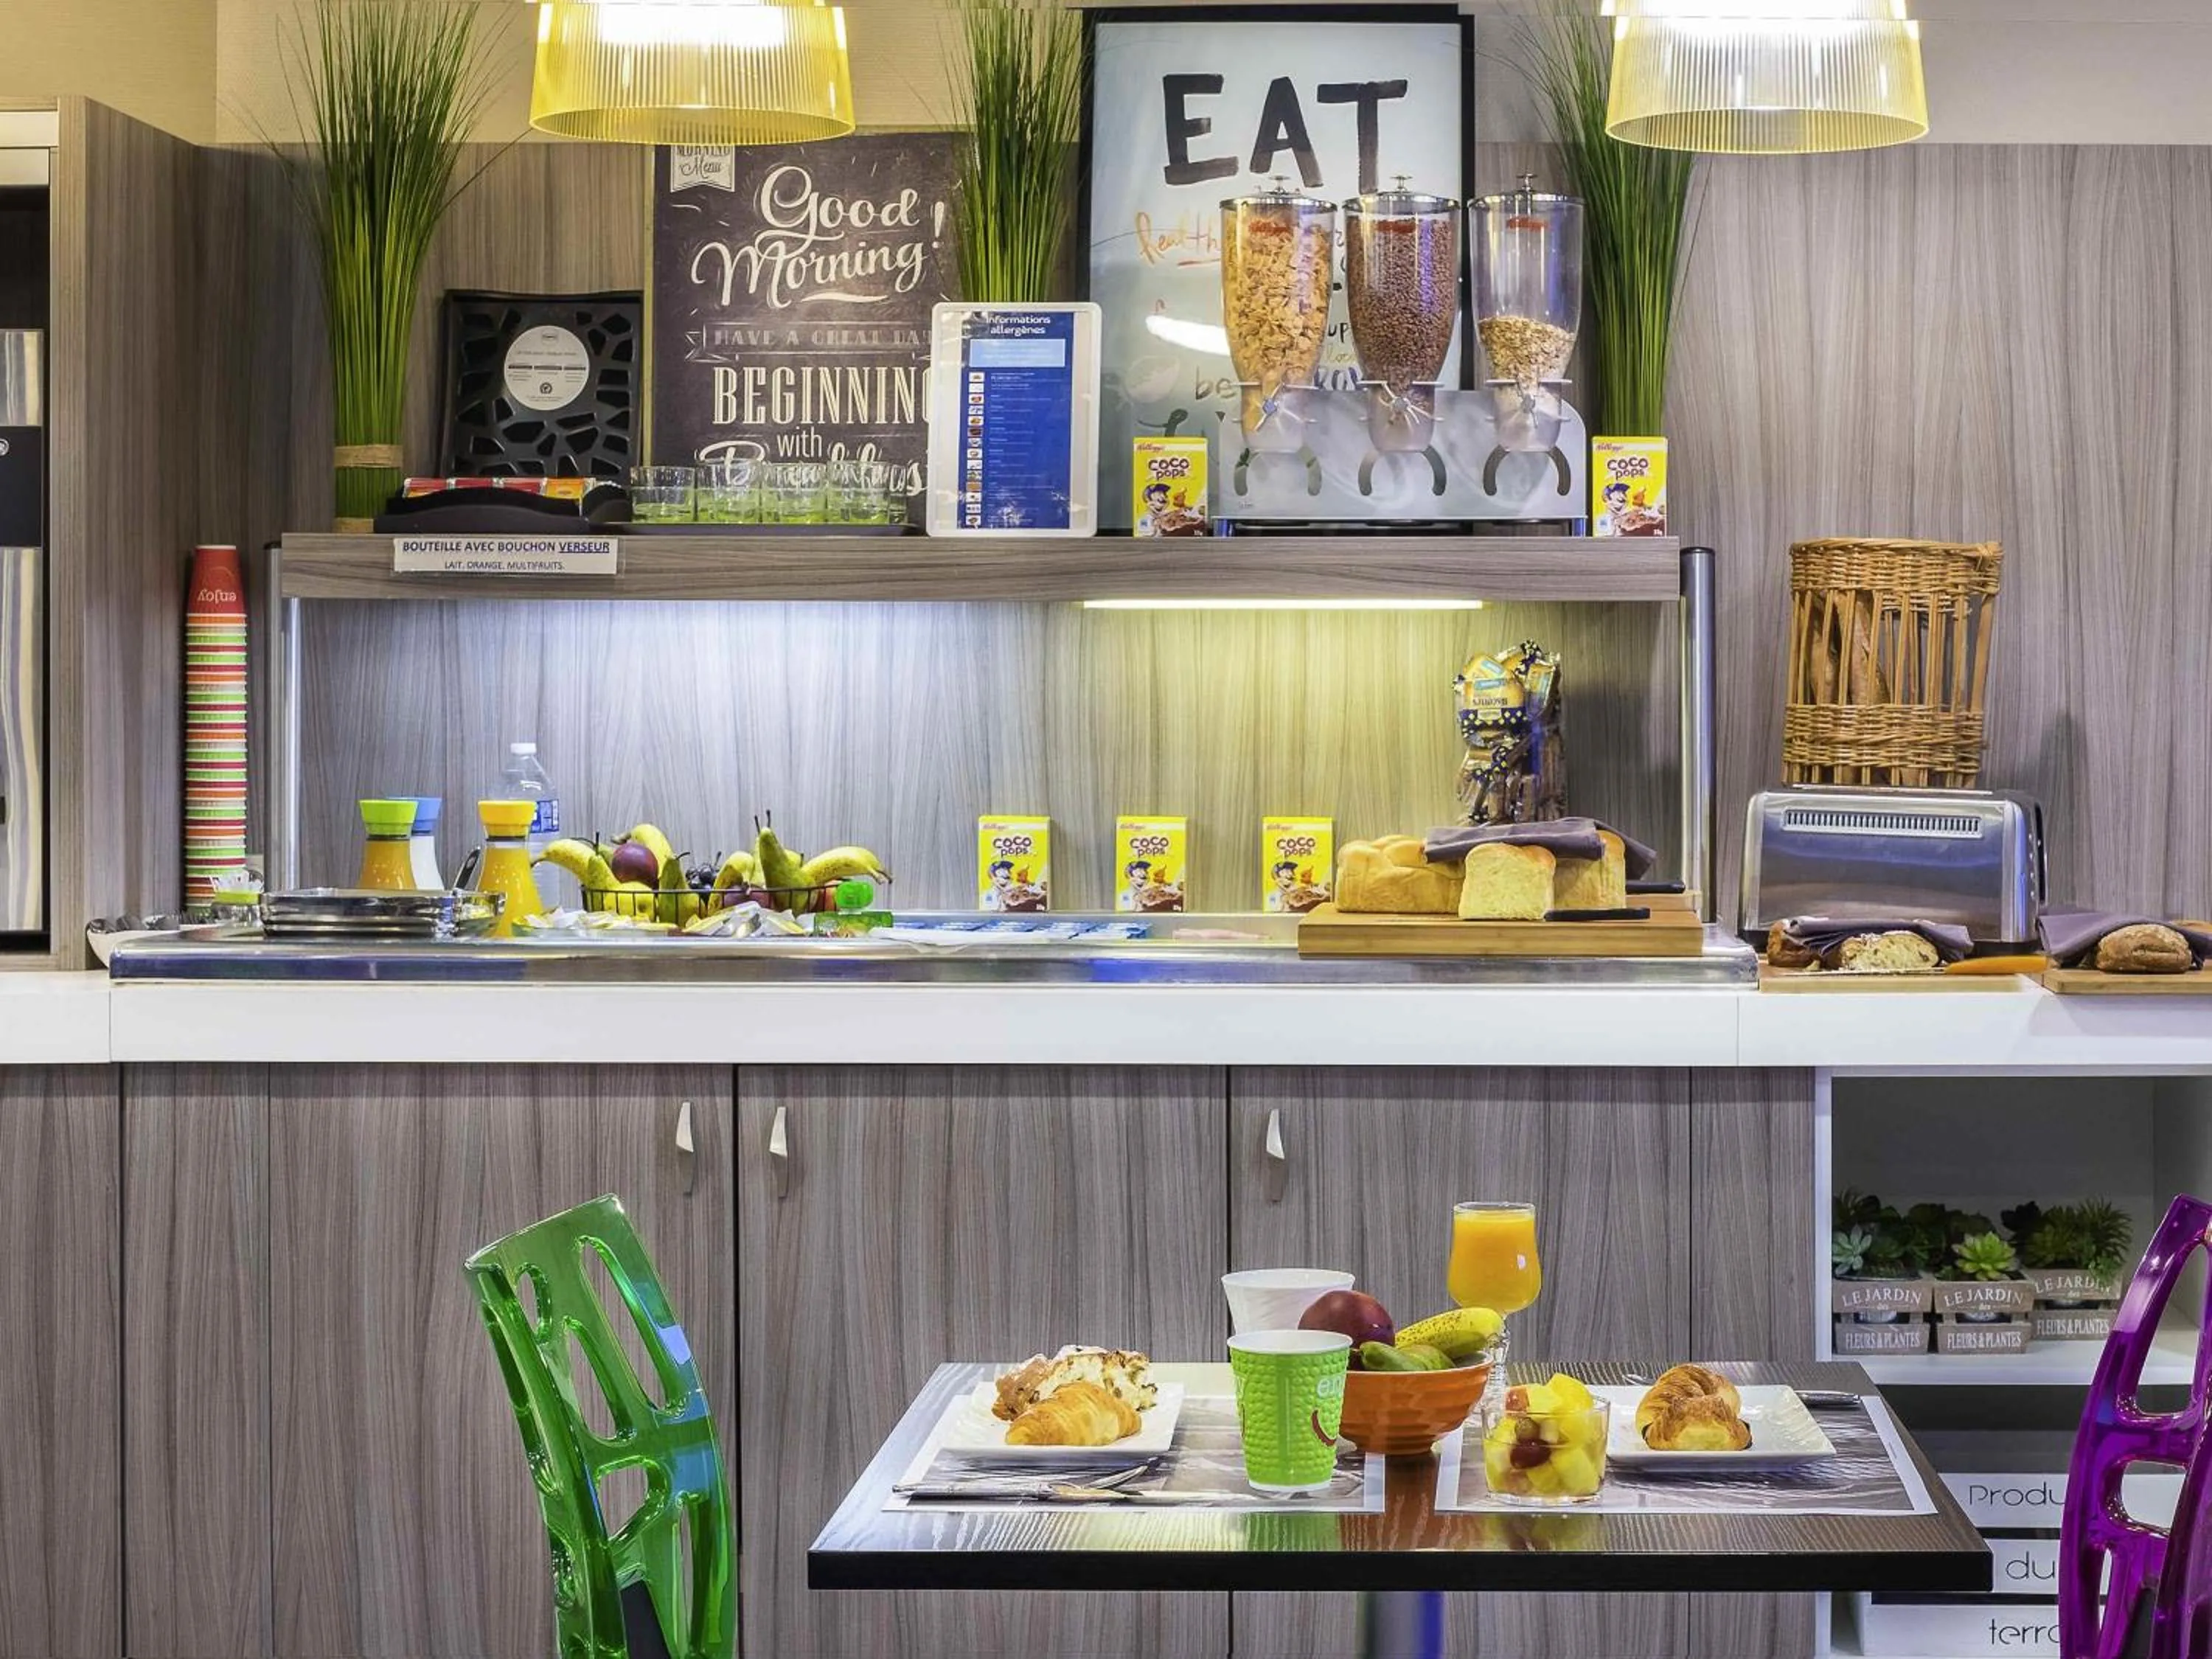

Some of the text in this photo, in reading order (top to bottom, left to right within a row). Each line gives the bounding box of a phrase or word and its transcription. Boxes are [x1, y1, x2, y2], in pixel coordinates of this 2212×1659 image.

[1164, 74, 1407, 195] EAT
[755, 166, 920, 260] Good
[691, 240, 928, 308] Morning
[714, 330, 774, 346] HAVE
[787, 331, 800, 346] A
[777, 428, 823, 458] with
[403, 542, 610, 553] BOUTEILLE AVEC BOUCHON VERSEUR
[1842, 1288, 1922, 1307] LE JARDIN
[1944, 1288, 2023, 1307] LE JARDIN
[1969, 1481, 2065, 1506] Produ
[2006, 1551, 2055, 1579] du
